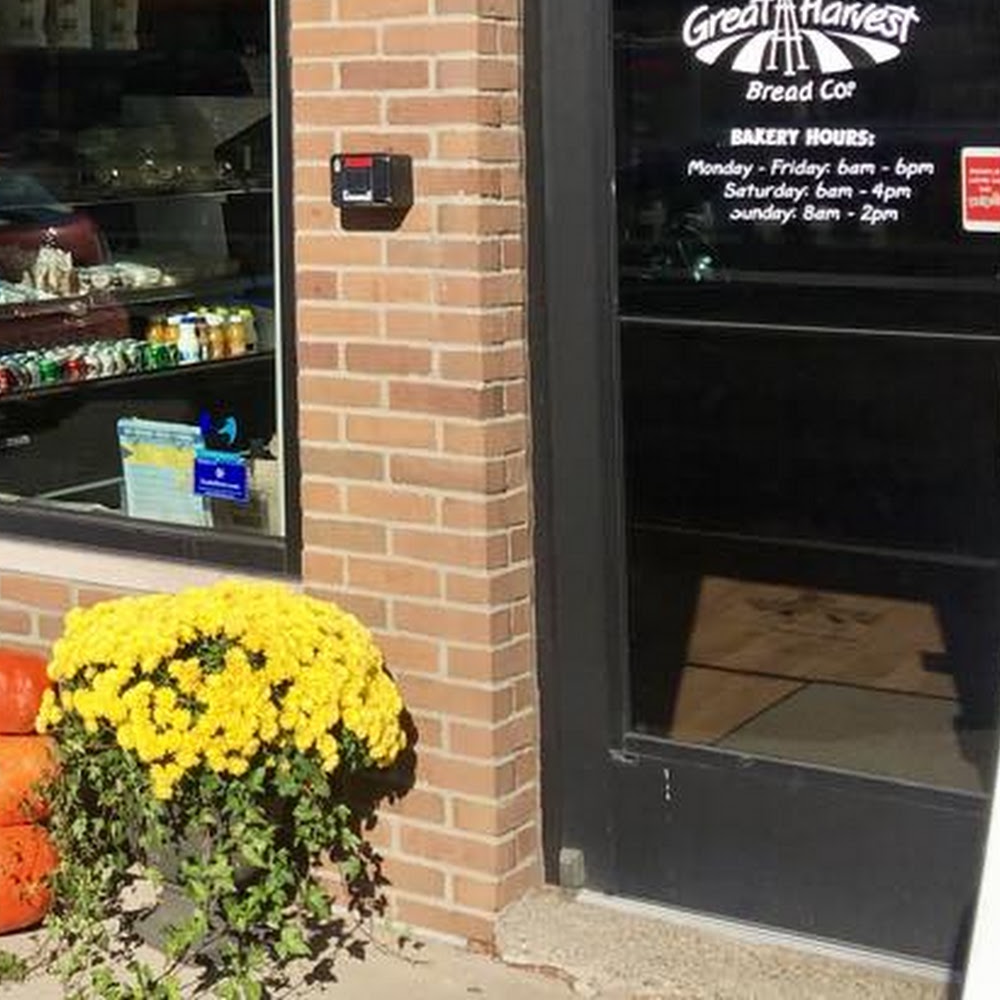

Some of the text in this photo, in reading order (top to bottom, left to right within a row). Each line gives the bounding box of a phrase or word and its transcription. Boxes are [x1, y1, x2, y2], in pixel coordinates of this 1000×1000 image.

[746, 80, 813, 101] Bread
[730, 127, 876, 148] BAKERY HOURS:
[687, 159, 753, 179] Monday
[837, 158, 876, 175] 6am
[894, 157, 935, 179] 6pm
[815, 181, 853, 199] 6am
[871, 181, 912, 203] 4pm
[802, 204, 841, 221] 8am
[859, 203, 899, 225] 2pm
